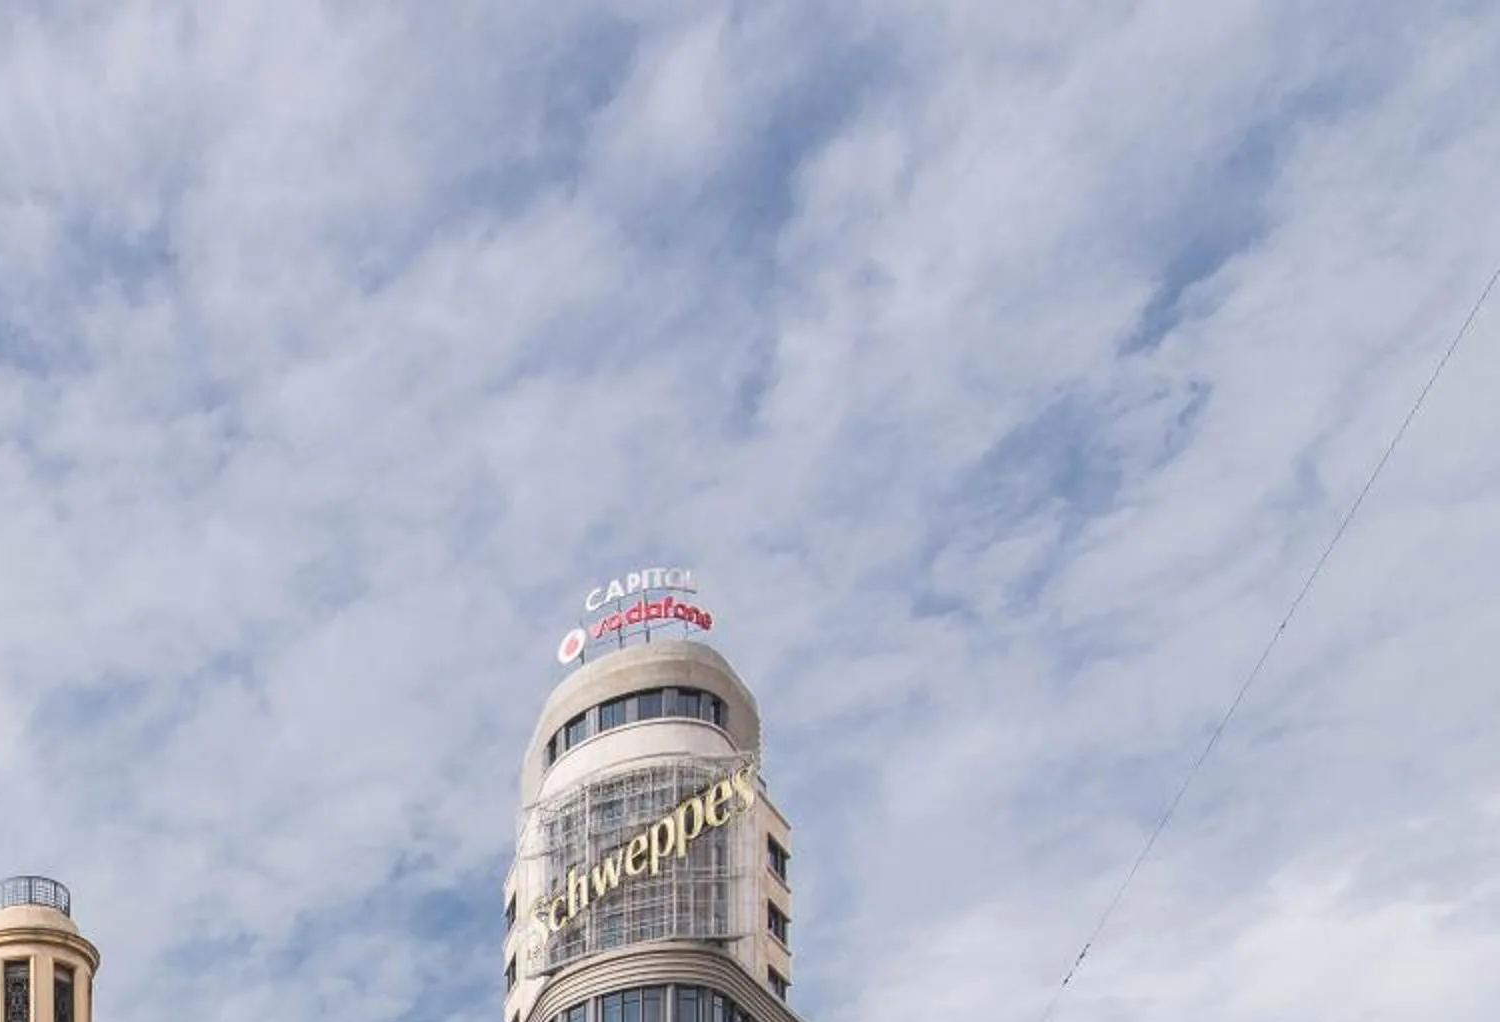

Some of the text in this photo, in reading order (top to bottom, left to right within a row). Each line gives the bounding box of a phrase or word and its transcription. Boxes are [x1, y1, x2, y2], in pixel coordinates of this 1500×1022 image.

[585, 567, 697, 611] CAPITOL
[589, 596, 713, 639] vodafone
[514, 757, 756, 955] Schweppes
